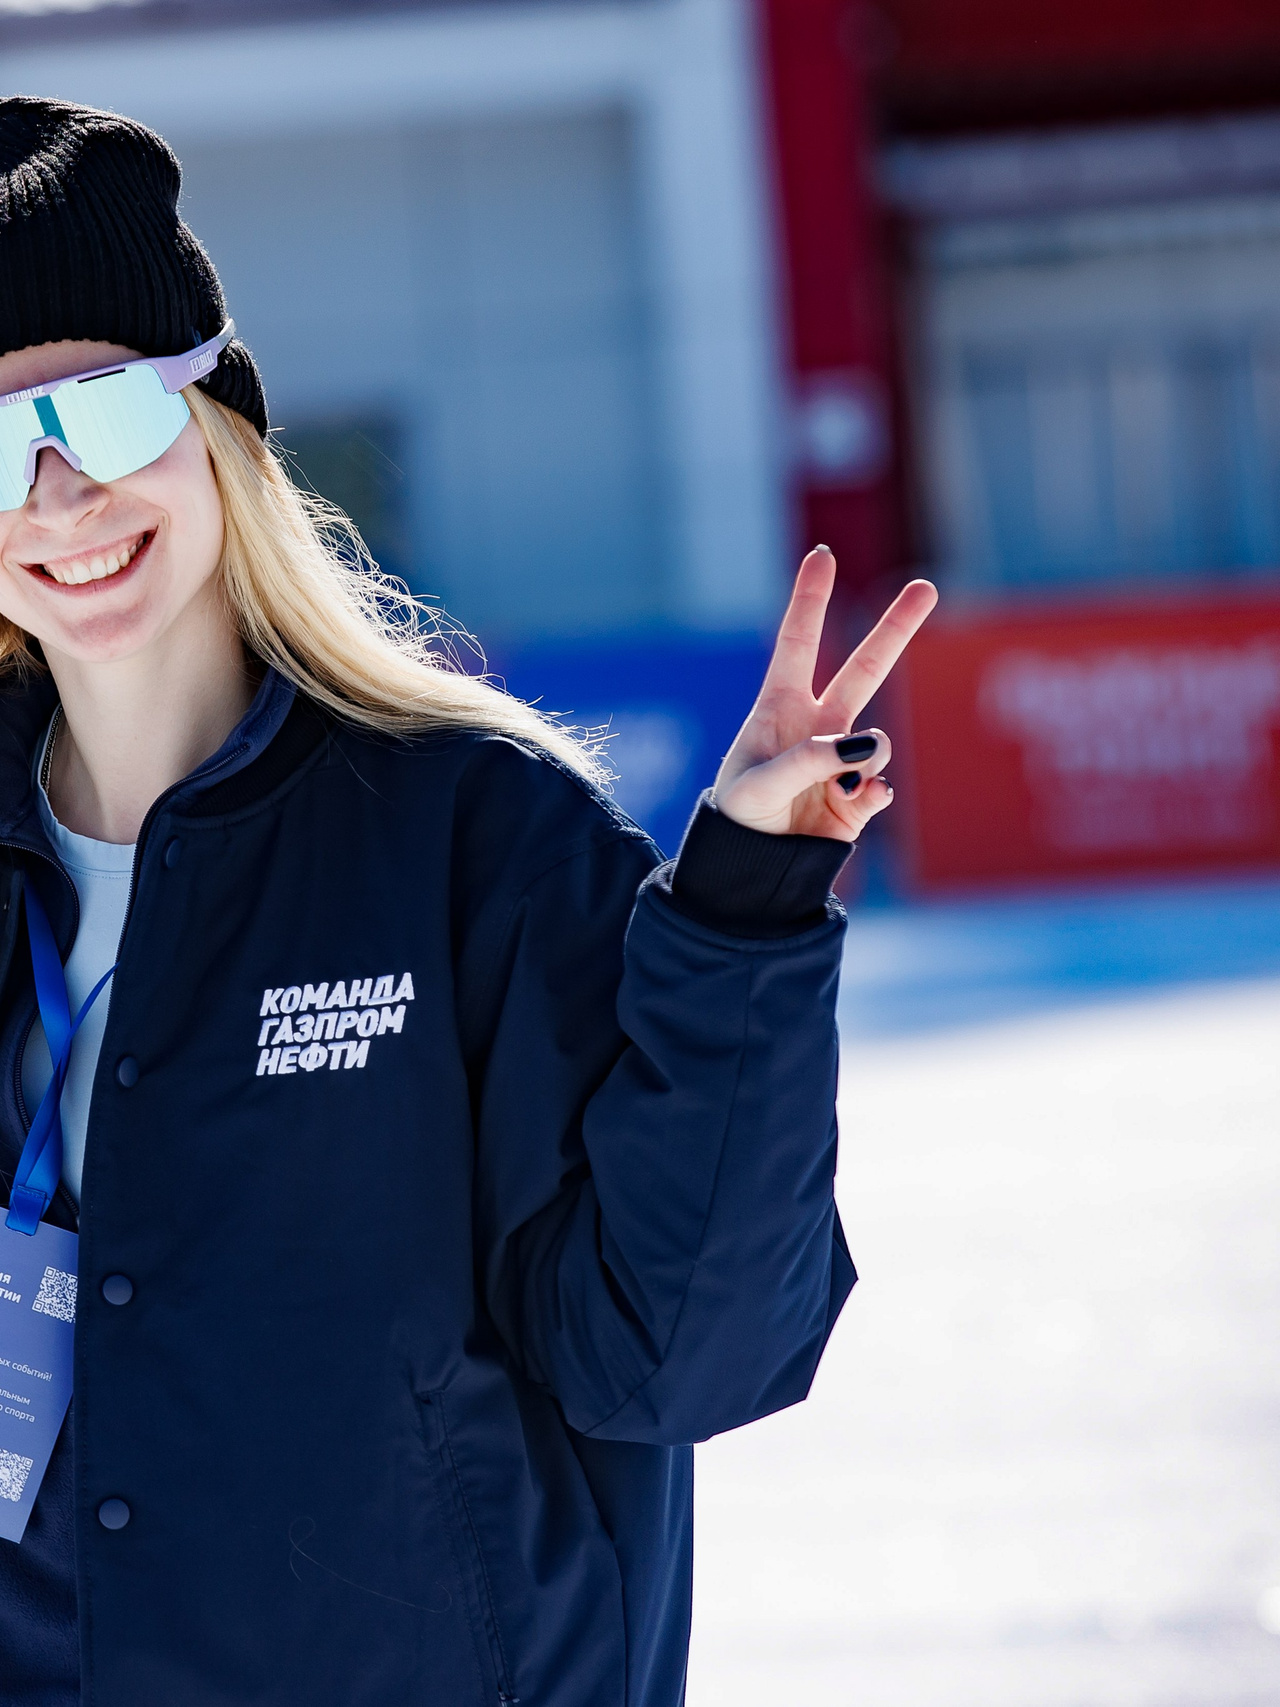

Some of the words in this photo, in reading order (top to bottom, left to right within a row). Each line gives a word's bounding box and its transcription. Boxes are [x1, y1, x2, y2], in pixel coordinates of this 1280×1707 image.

[259, 972, 415, 1016] КОМАНДА
[257, 1004, 406, 1046] ГАЗПРОМ
[256, 1040, 371, 1076] НЕФТИ
[11, 1362, 53, 1382] событий!
[4, 1406, 36, 1423] спорта
